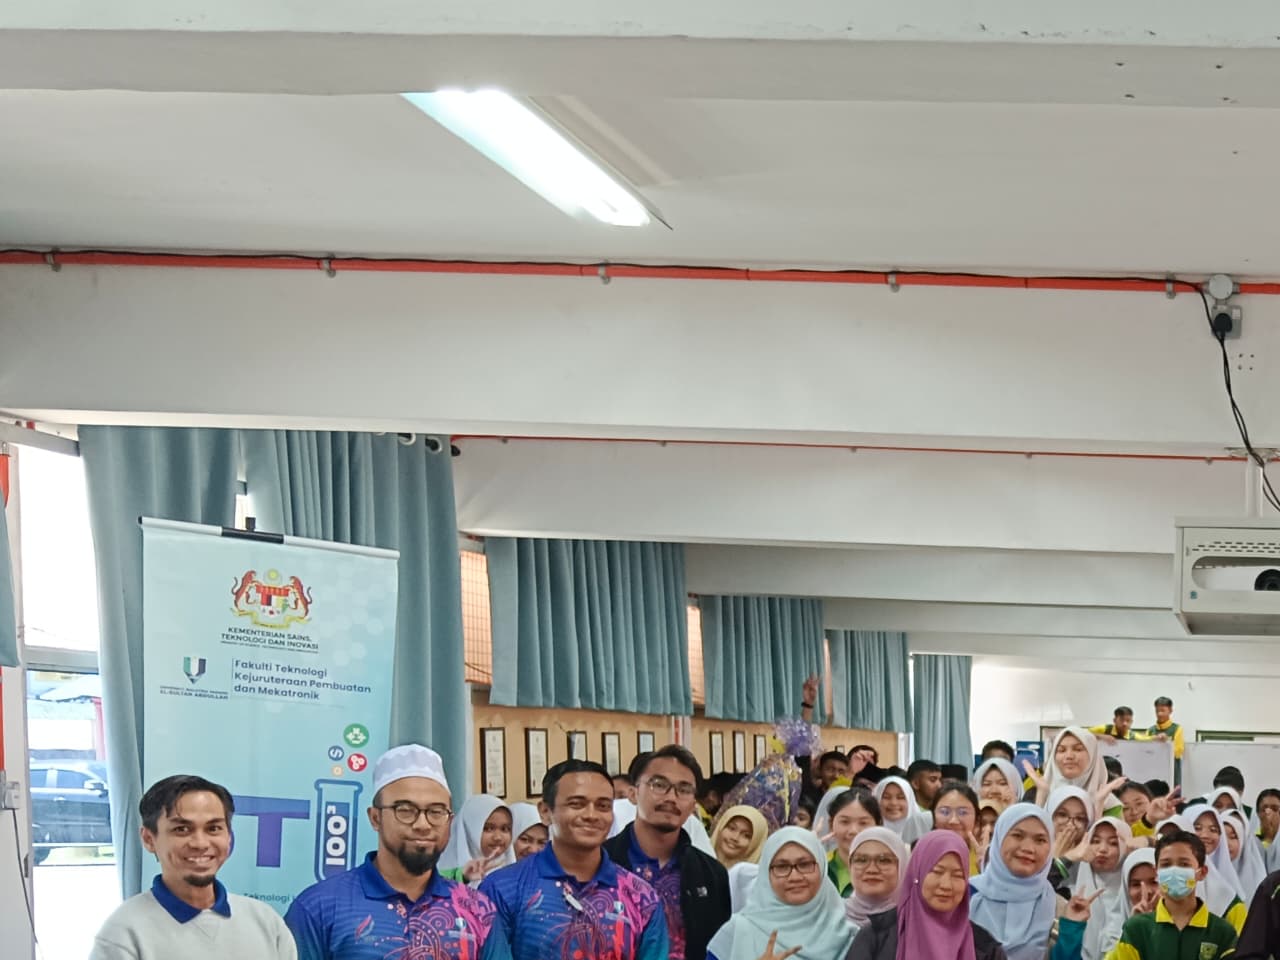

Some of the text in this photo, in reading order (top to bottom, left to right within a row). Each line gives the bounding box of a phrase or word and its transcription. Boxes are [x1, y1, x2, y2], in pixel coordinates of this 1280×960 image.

[228, 627, 285, 638] KEMENTERIAN
[221, 633, 266, 644] TEKNOLOGI
[268, 638, 285, 647] DAN
[287, 640, 319, 650] INOVASI
[235, 660, 327, 679] Fakulti Teknologi
[234, 672, 371, 693] Kejuruteraan Pembuatan
[234, 684, 256, 693] dan
[258, 686, 320, 700] Mekatronik
